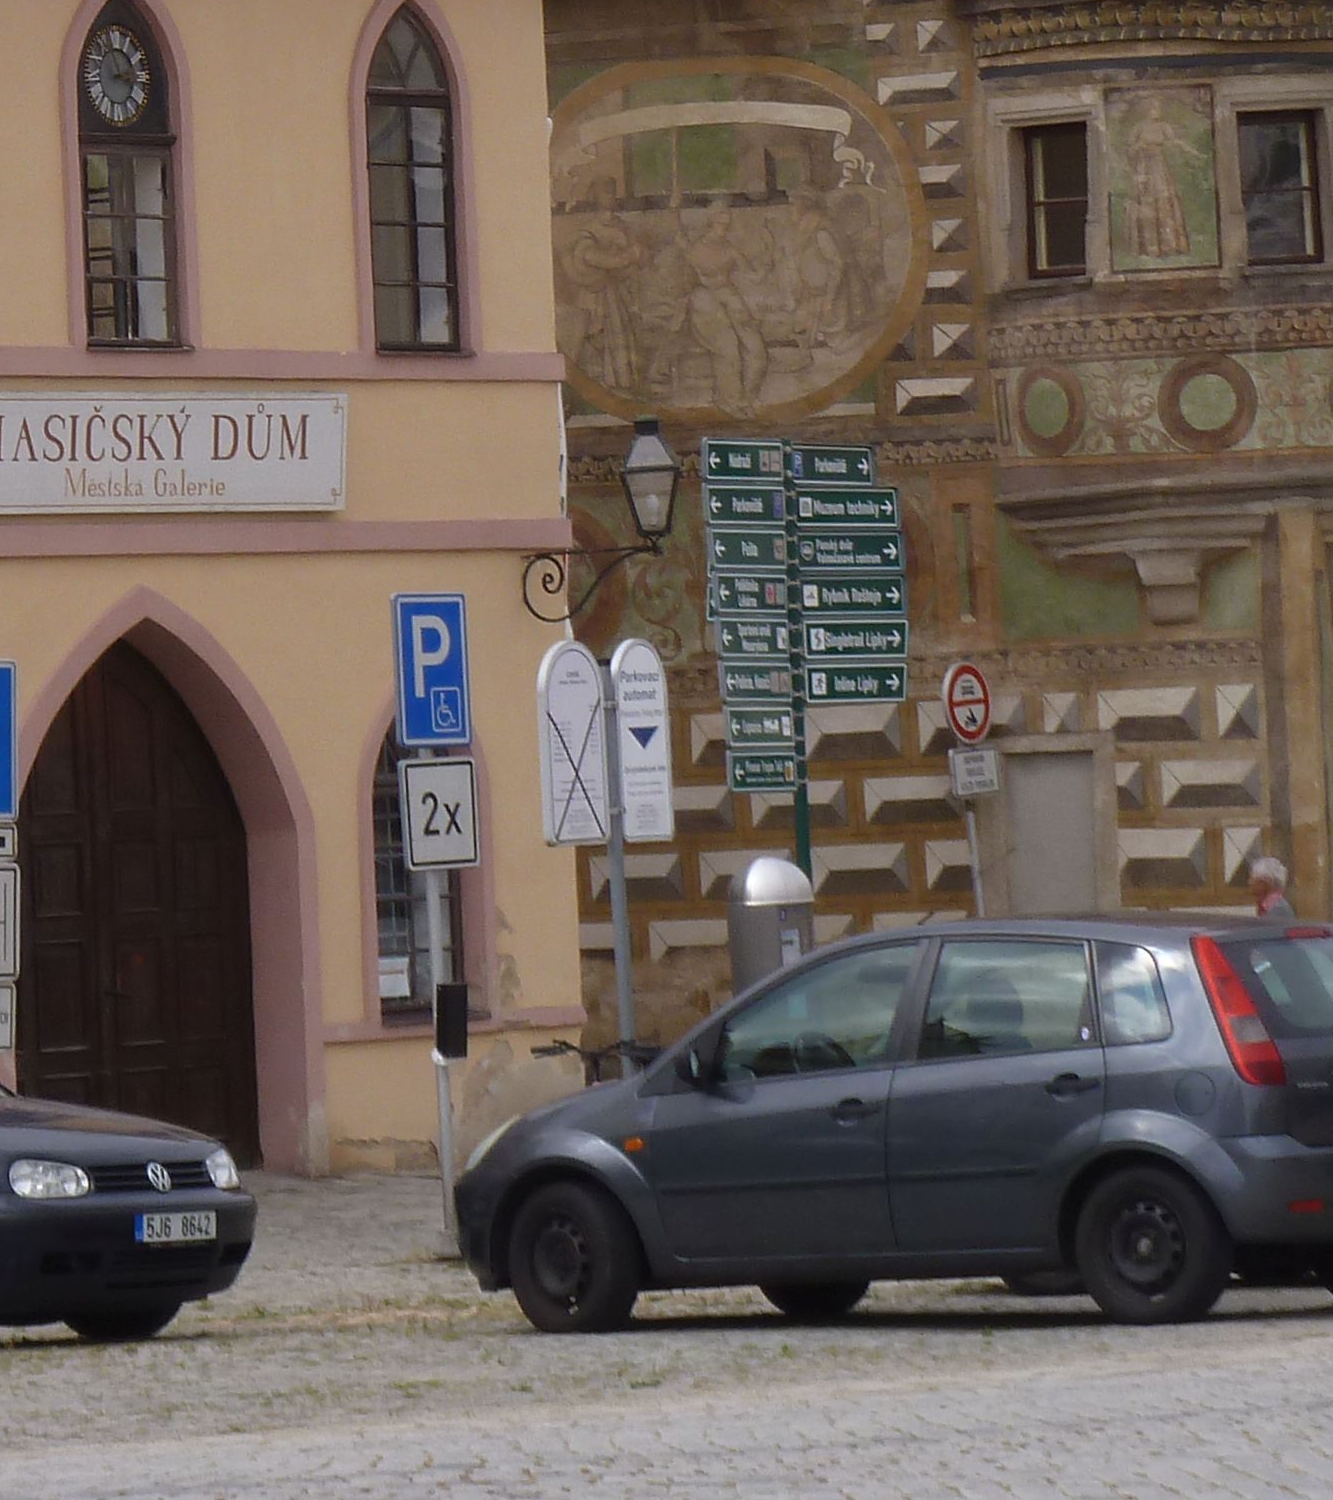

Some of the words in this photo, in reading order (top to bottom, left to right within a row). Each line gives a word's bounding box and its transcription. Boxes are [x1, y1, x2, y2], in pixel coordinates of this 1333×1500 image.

[210, 403, 310, 461] DŮM
[153, 468, 226, 497] Galerie
[814, 500, 845, 514] Muzeum
[846, 500, 879, 518] techniky
[825, 629, 865, 650] Singletrail
[866, 628, 887, 649] Lipky
[411, 614, 451, 698] P
[623, 689, 657, 701] automat
[834, 676, 856, 692] Inline
[857, 674, 879, 695] Lipky
[421, 791, 462, 836] 2x
